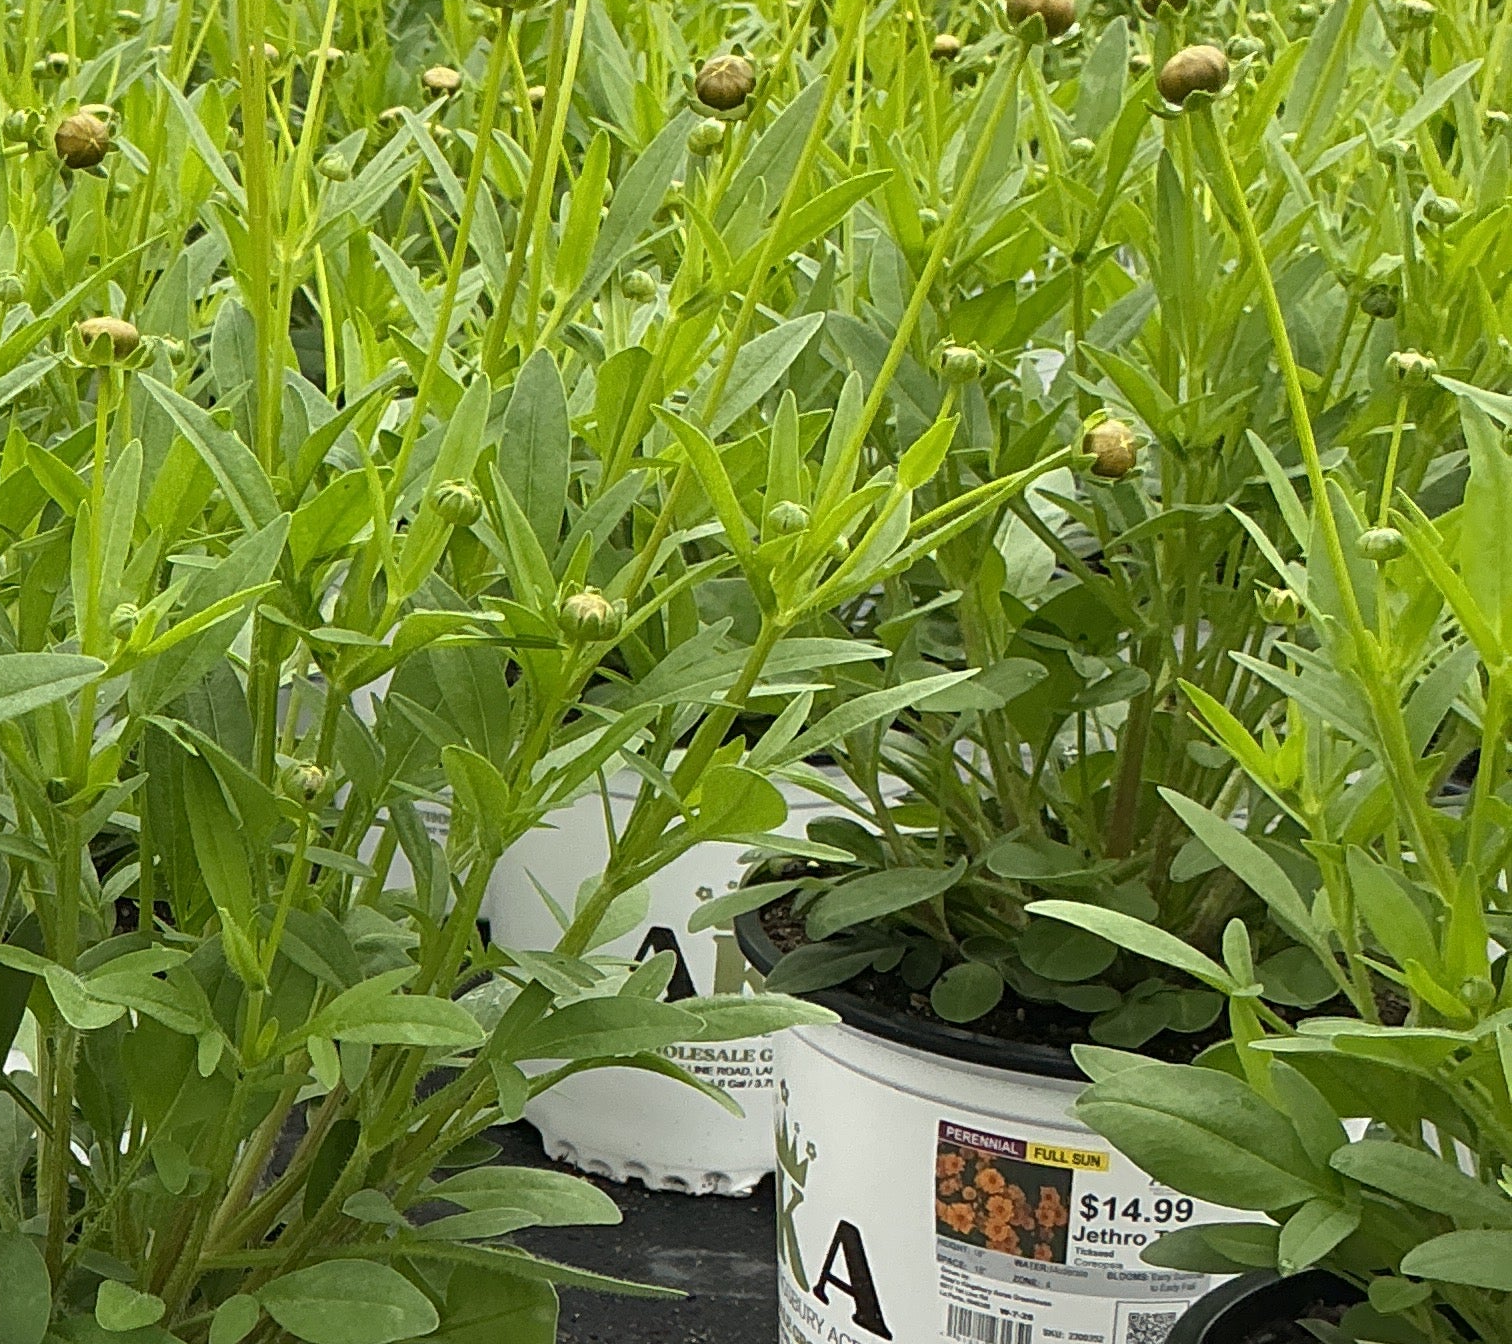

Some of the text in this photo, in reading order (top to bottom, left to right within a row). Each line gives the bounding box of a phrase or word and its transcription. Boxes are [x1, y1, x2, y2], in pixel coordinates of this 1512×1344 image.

[656, 1045, 757, 1063] OLESALE
[945, 1126, 1101, 1167] PERENNIAL FULL SUN
[1079, 1193, 1194, 1224] $14.99
[1072, 1225, 1147, 1246] Jethro
